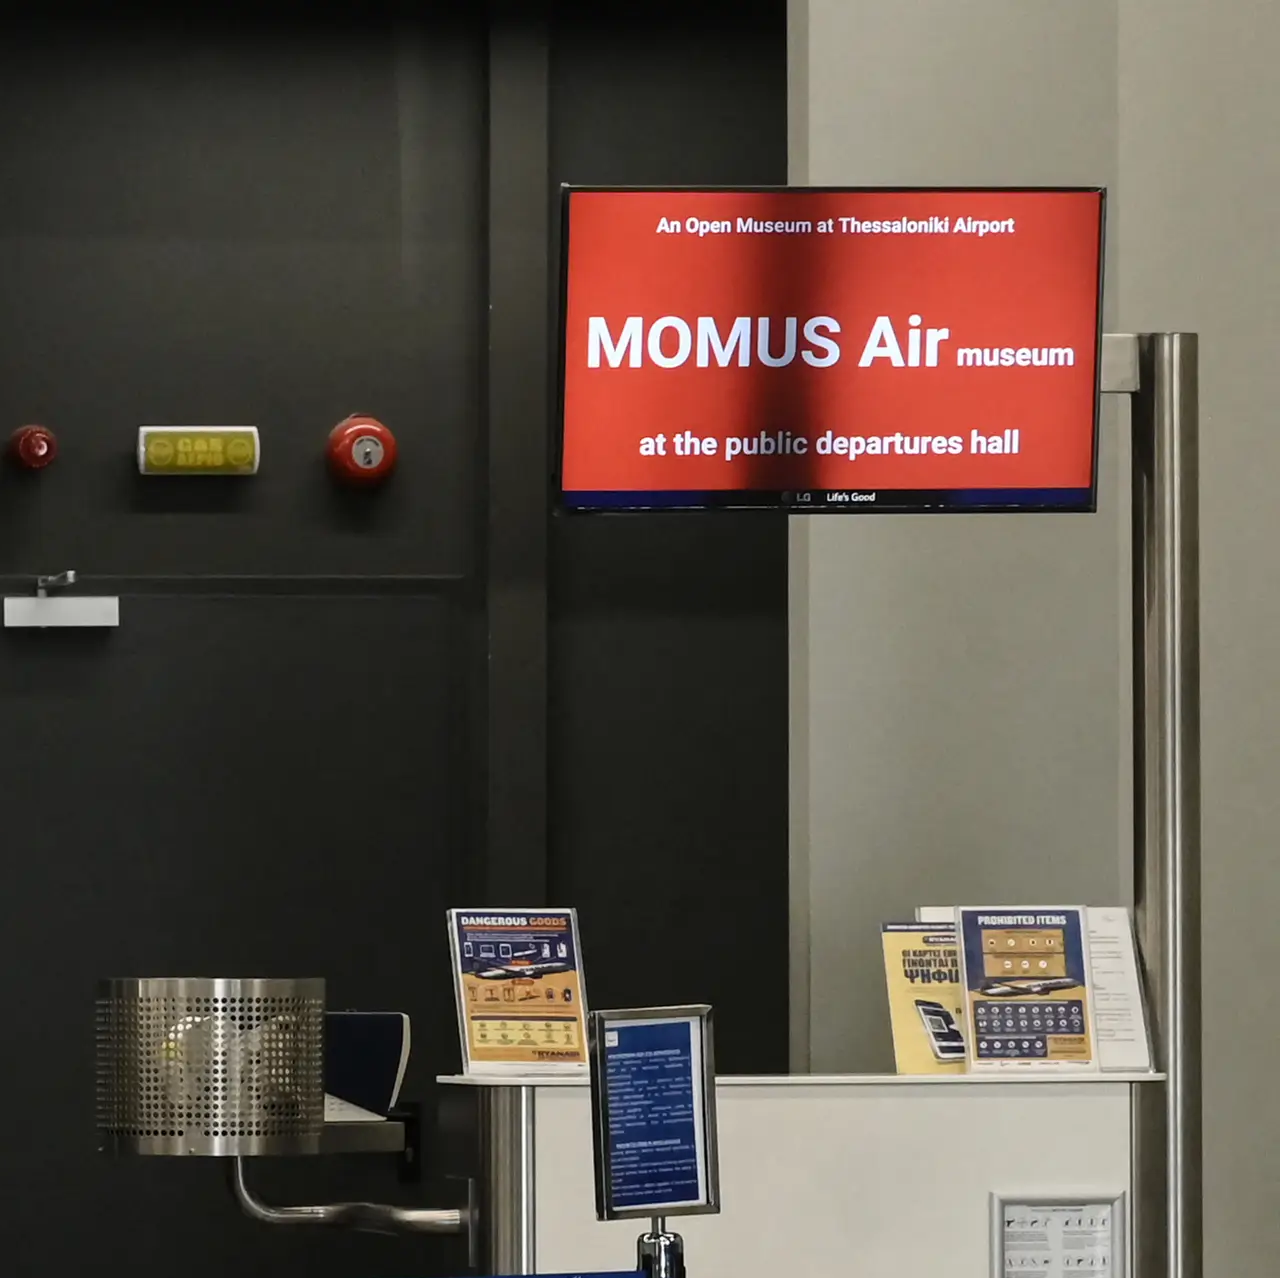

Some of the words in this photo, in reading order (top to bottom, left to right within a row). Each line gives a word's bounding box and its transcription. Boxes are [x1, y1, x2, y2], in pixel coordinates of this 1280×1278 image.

[656, 217, 681, 233] An
[685, 217, 731, 236] Open
[736, 217, 811, 233] Museum
[817, 219, 834, 233] at
[838, 217, 949, 233] Thessaloniki
[953, 217, 1015, 236] Airport
[586, 315, 841, 369] MOMUS
[858, 314, 949, 367] Air
[956, 345, 1074, 367] museum
[639, 434, 668, 456] at
[672, 432, 718, 456] the
[724, 432, 809, 461] public
[815, 430, 963, 461] departures
[970, 429, 1020, 455] hall
[826, 492, 849, 502] Life's
[851, 492, 876, 502] Good
[461, 916, 528, 926] DANGEROUS
[529, 917, 567, 927] GOODS
[977, 915, 1035, 925] PROHIBITED
[1036, 915, 1067, 925] ITEMS
